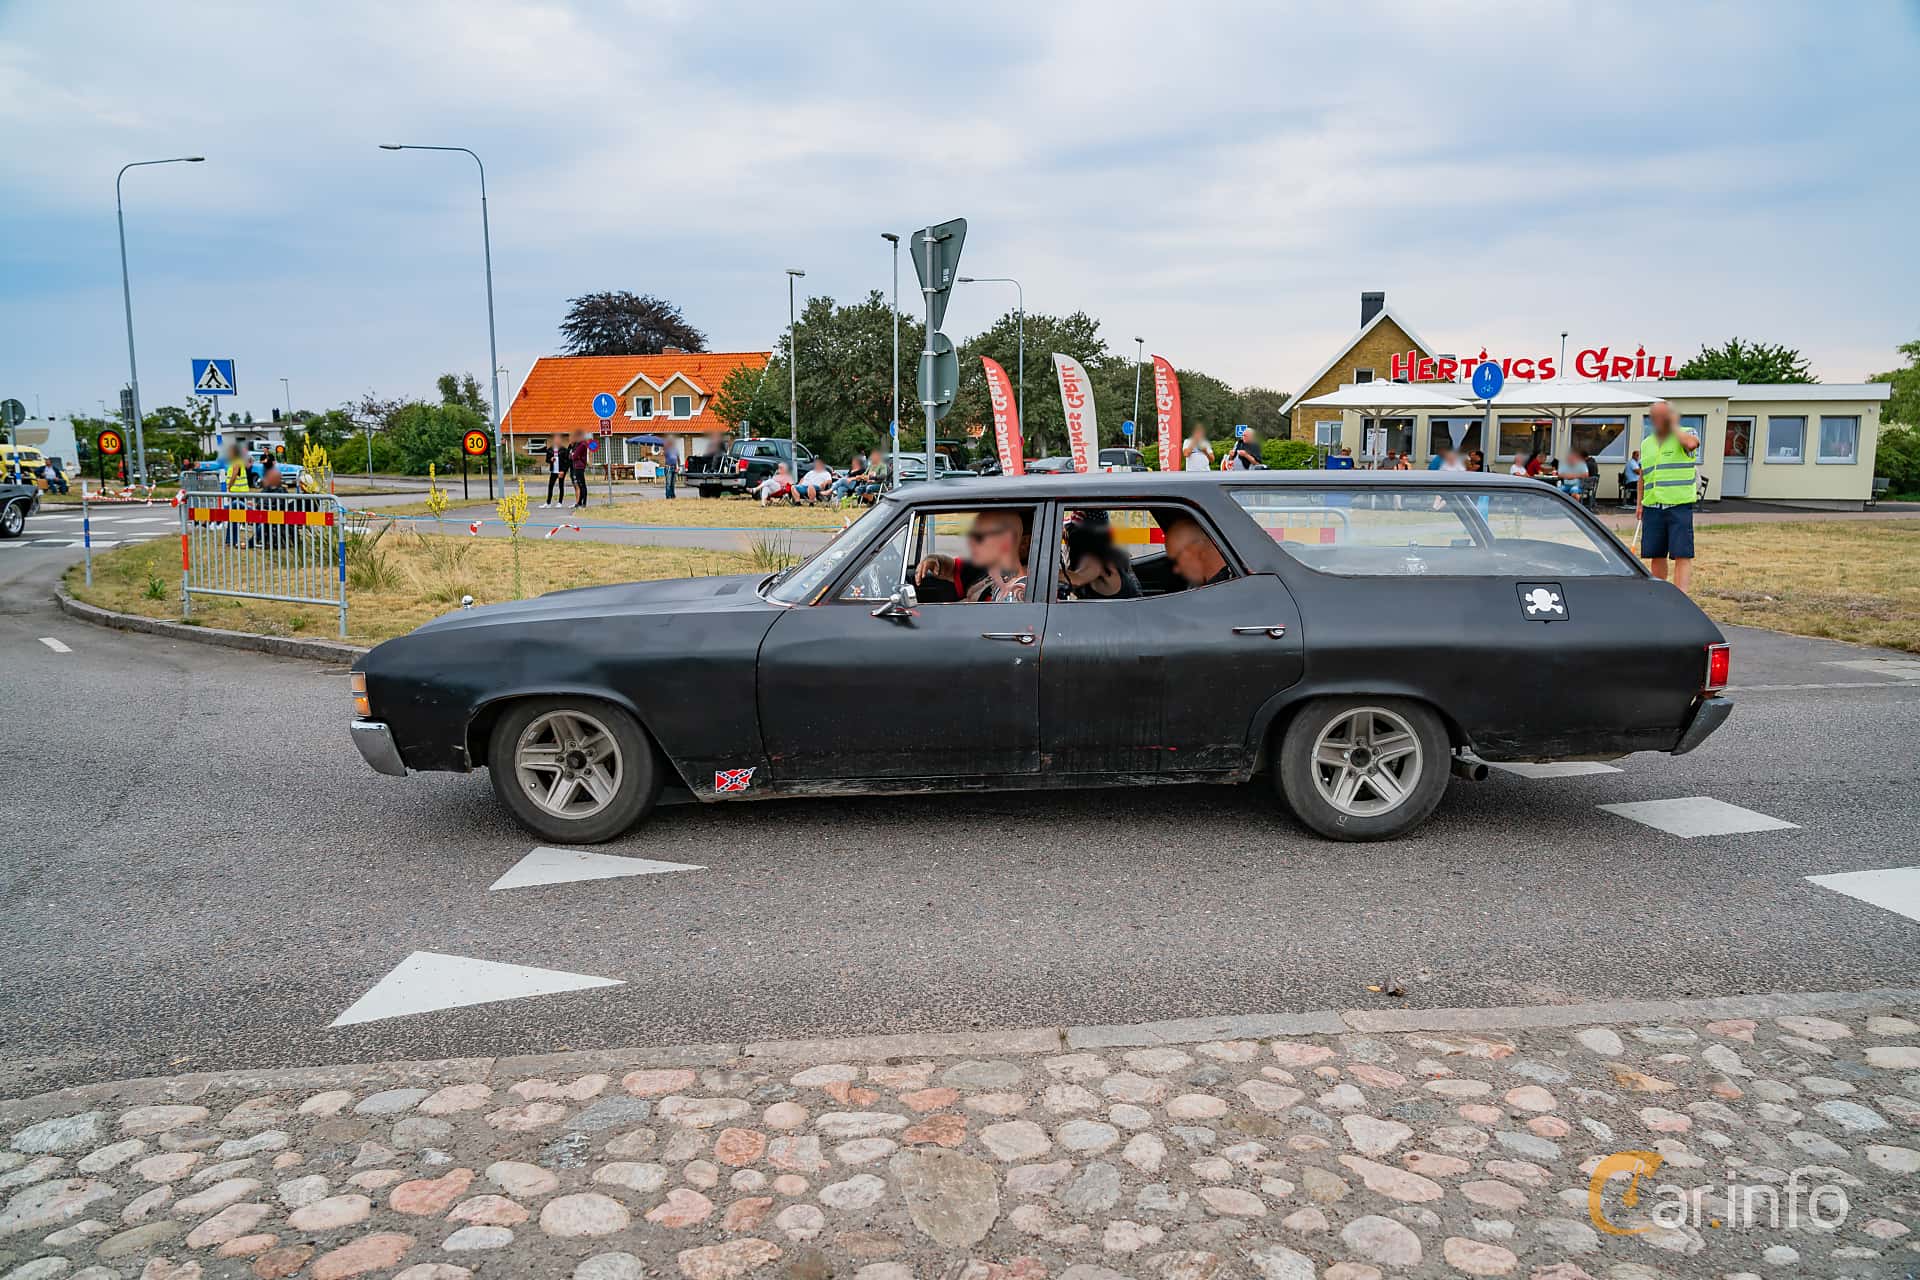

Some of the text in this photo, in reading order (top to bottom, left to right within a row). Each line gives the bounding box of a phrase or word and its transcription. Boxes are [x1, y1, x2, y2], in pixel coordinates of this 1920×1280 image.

[1391, 349, 1556, 382] HERTNGS
[103, 437, 118, 448] 30
[468, 437, 484, 449] 30
